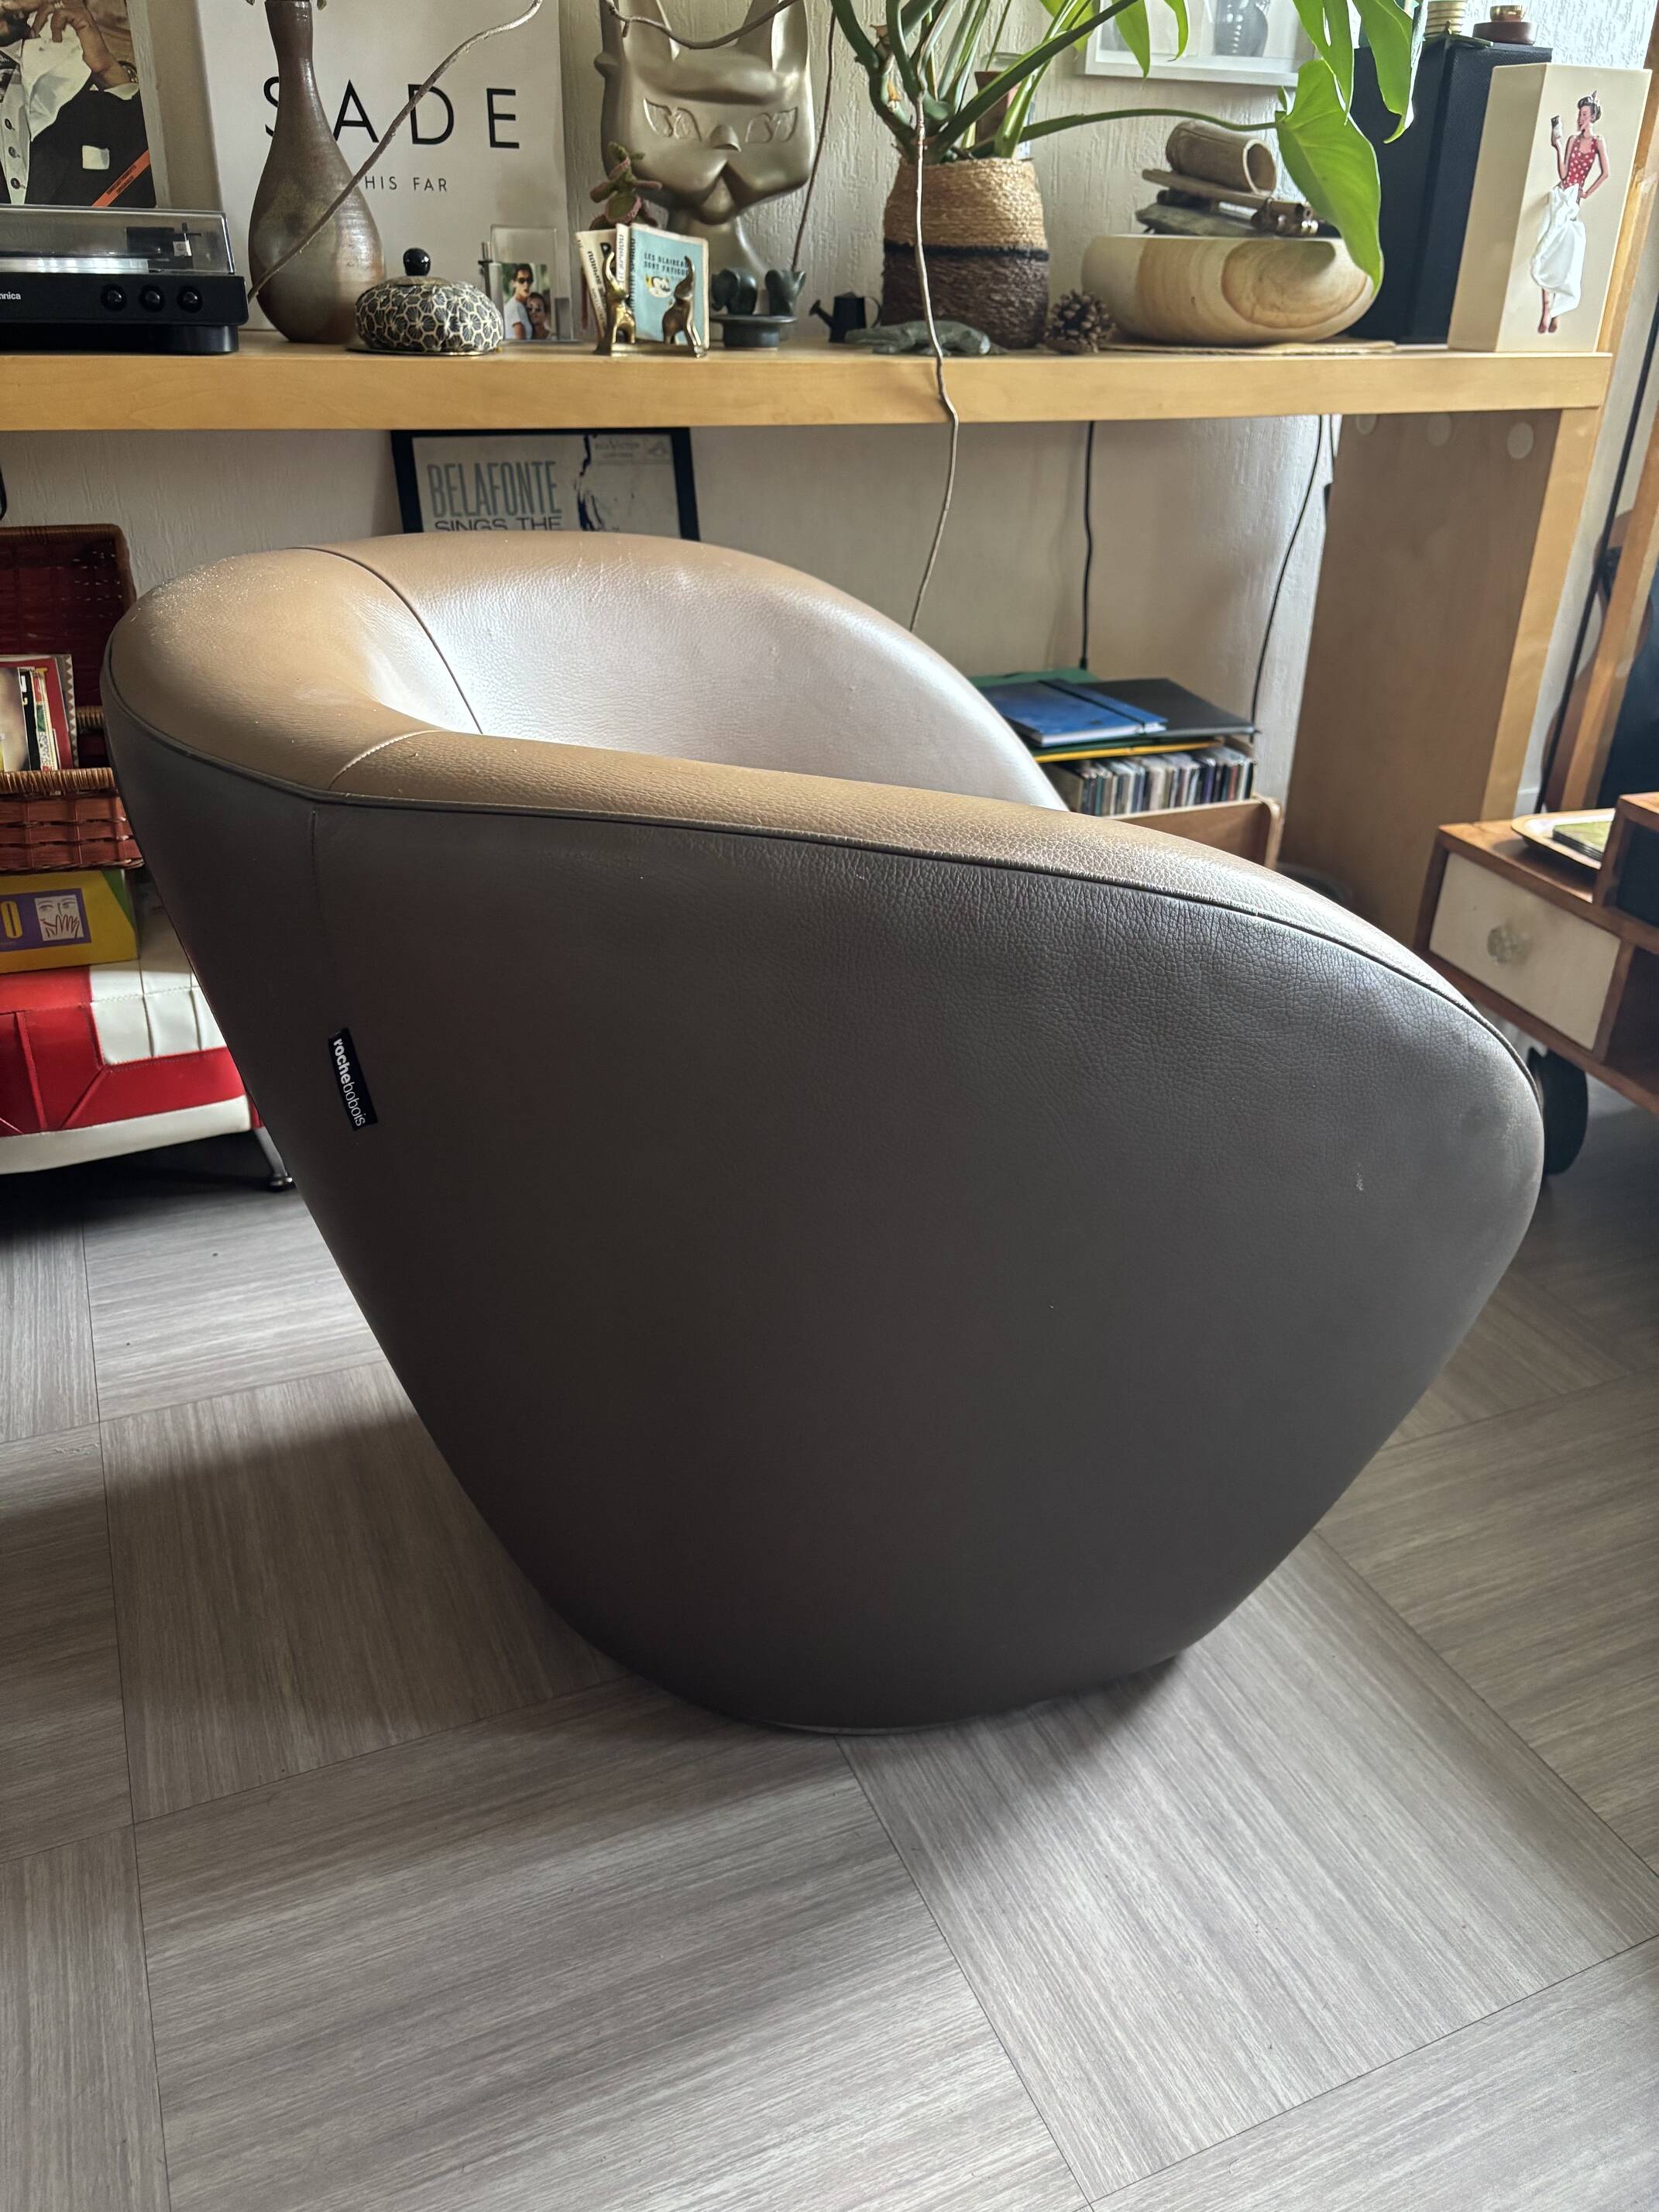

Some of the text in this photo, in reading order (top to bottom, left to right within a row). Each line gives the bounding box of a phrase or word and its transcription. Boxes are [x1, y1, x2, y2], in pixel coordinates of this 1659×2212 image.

[413, 177, 448, 192] FAR
[427, 461, 562, 518] BELAFONTE
[434, 516, 562, 531] SINGS THE
[333, 1038, 366, 1127] rochebobois
